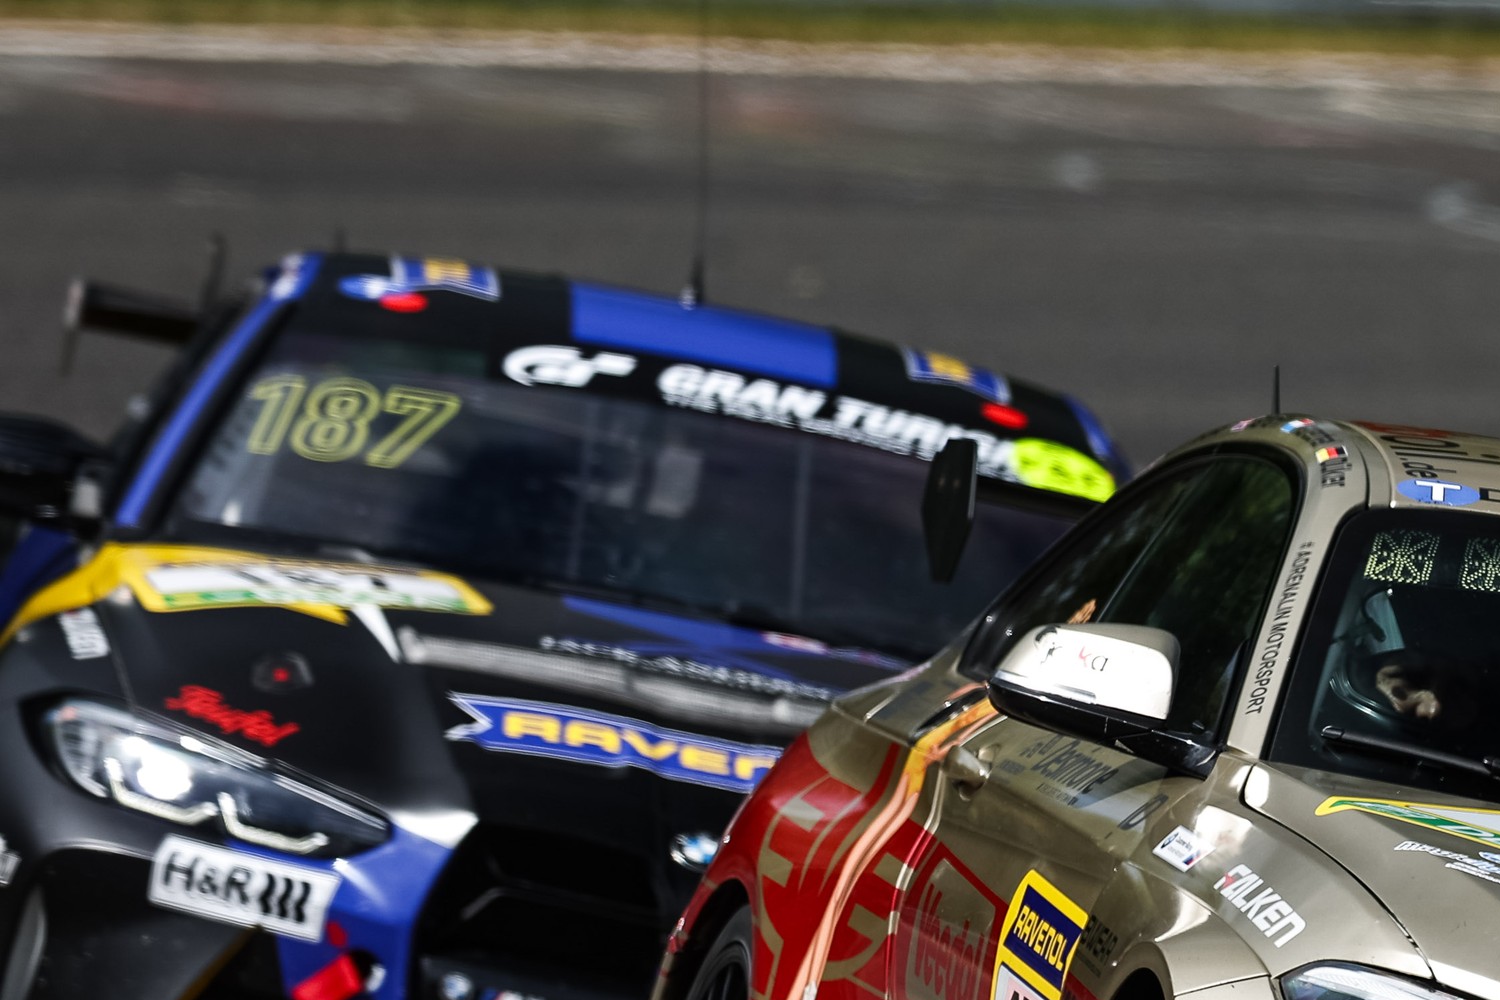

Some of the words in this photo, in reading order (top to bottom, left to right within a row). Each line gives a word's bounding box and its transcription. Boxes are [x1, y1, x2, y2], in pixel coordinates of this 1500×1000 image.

[248, 374, 461, 469] 187
[658, 362, 826, 424] GRAN
[1272, 551, 1312, 621] ADRENALIN
[1244, 621, 1289, 715] MOTORSPORT
[163, 851, 253, 907] H&R
[1213, 863, 1307, 949] FALKEN
[1012, 904, 1068, 972] RAVENOL
